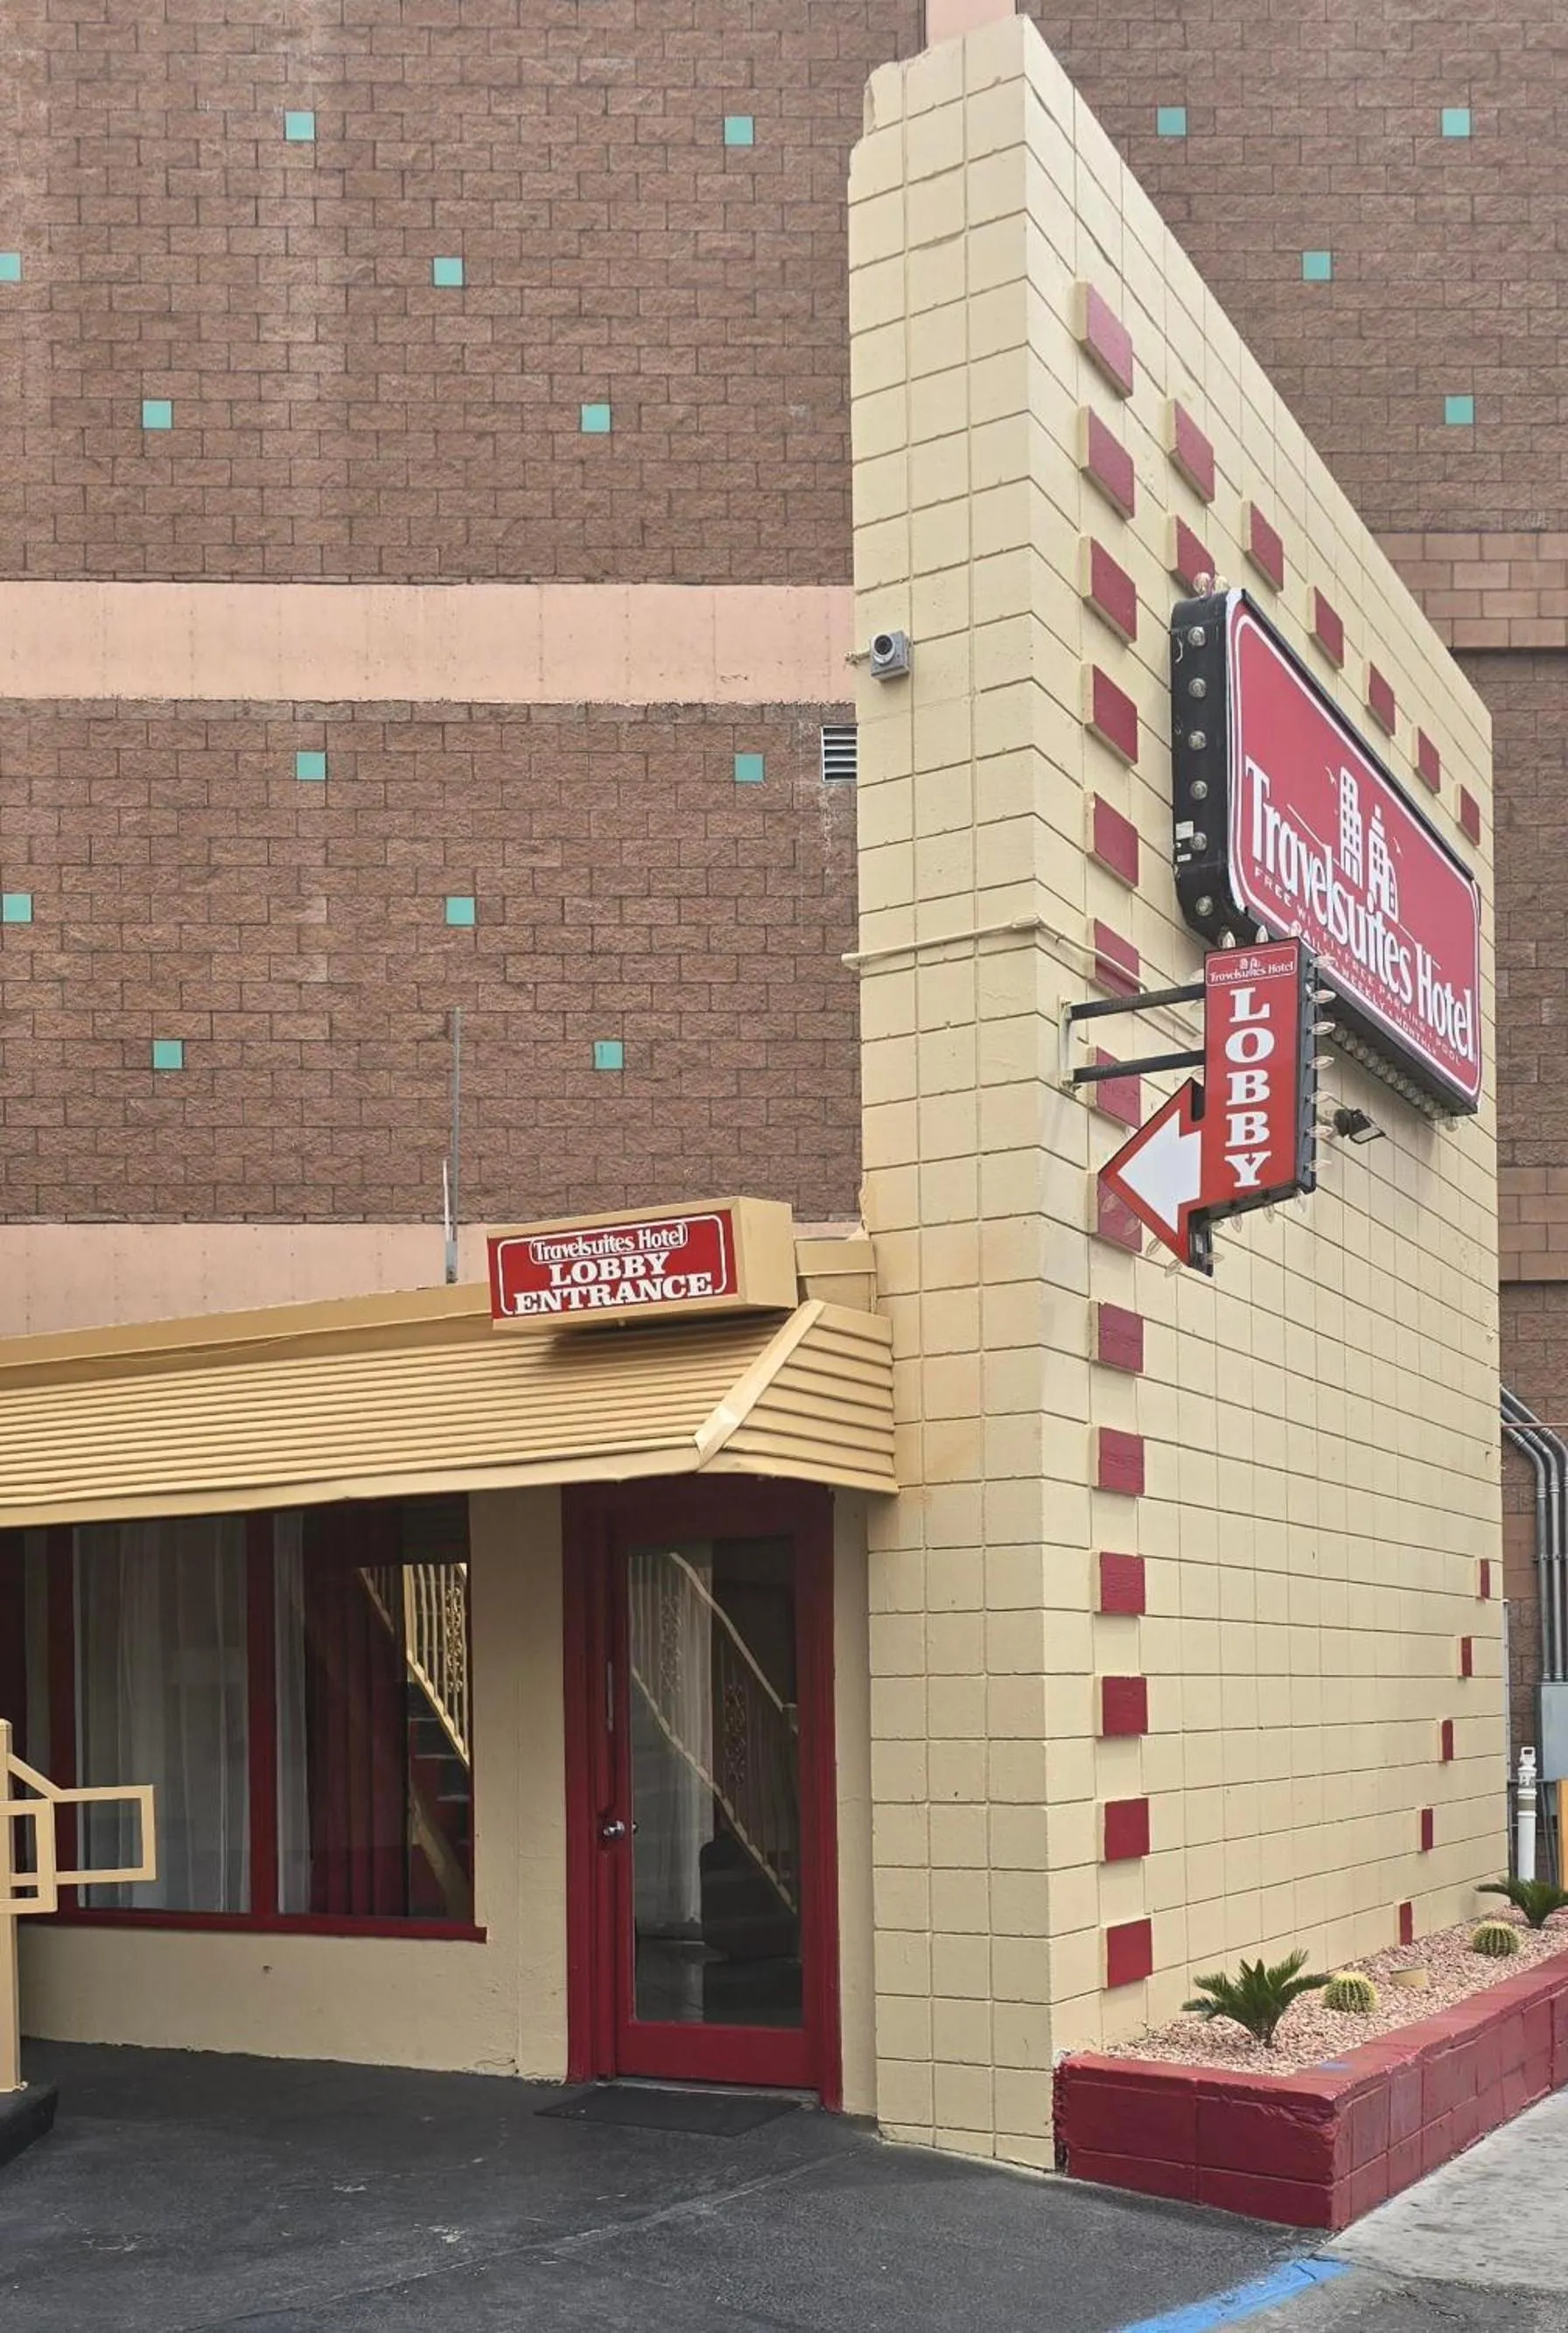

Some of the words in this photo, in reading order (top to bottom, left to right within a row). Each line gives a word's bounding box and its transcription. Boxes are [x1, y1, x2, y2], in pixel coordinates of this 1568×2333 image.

[1255, 865, 1292, 908] FREE
[1245, 754, 1412, 1005] Travelsuites
[1414, 942, 1474, 1062] Hotel
[1210, 967, 1266, 983] Travelsuites
[1268, 961, 1293, 974] Hotel
[1224, 986, 1275, 1188] LOBBY
[532, 1233, 634, 1262] Travelsuites
[638, 1223, 684, 1251] Hotel
[550, 1251, 670, 1286] LOBBY
[514, 1272, 713, 1314] ENTRANCE
